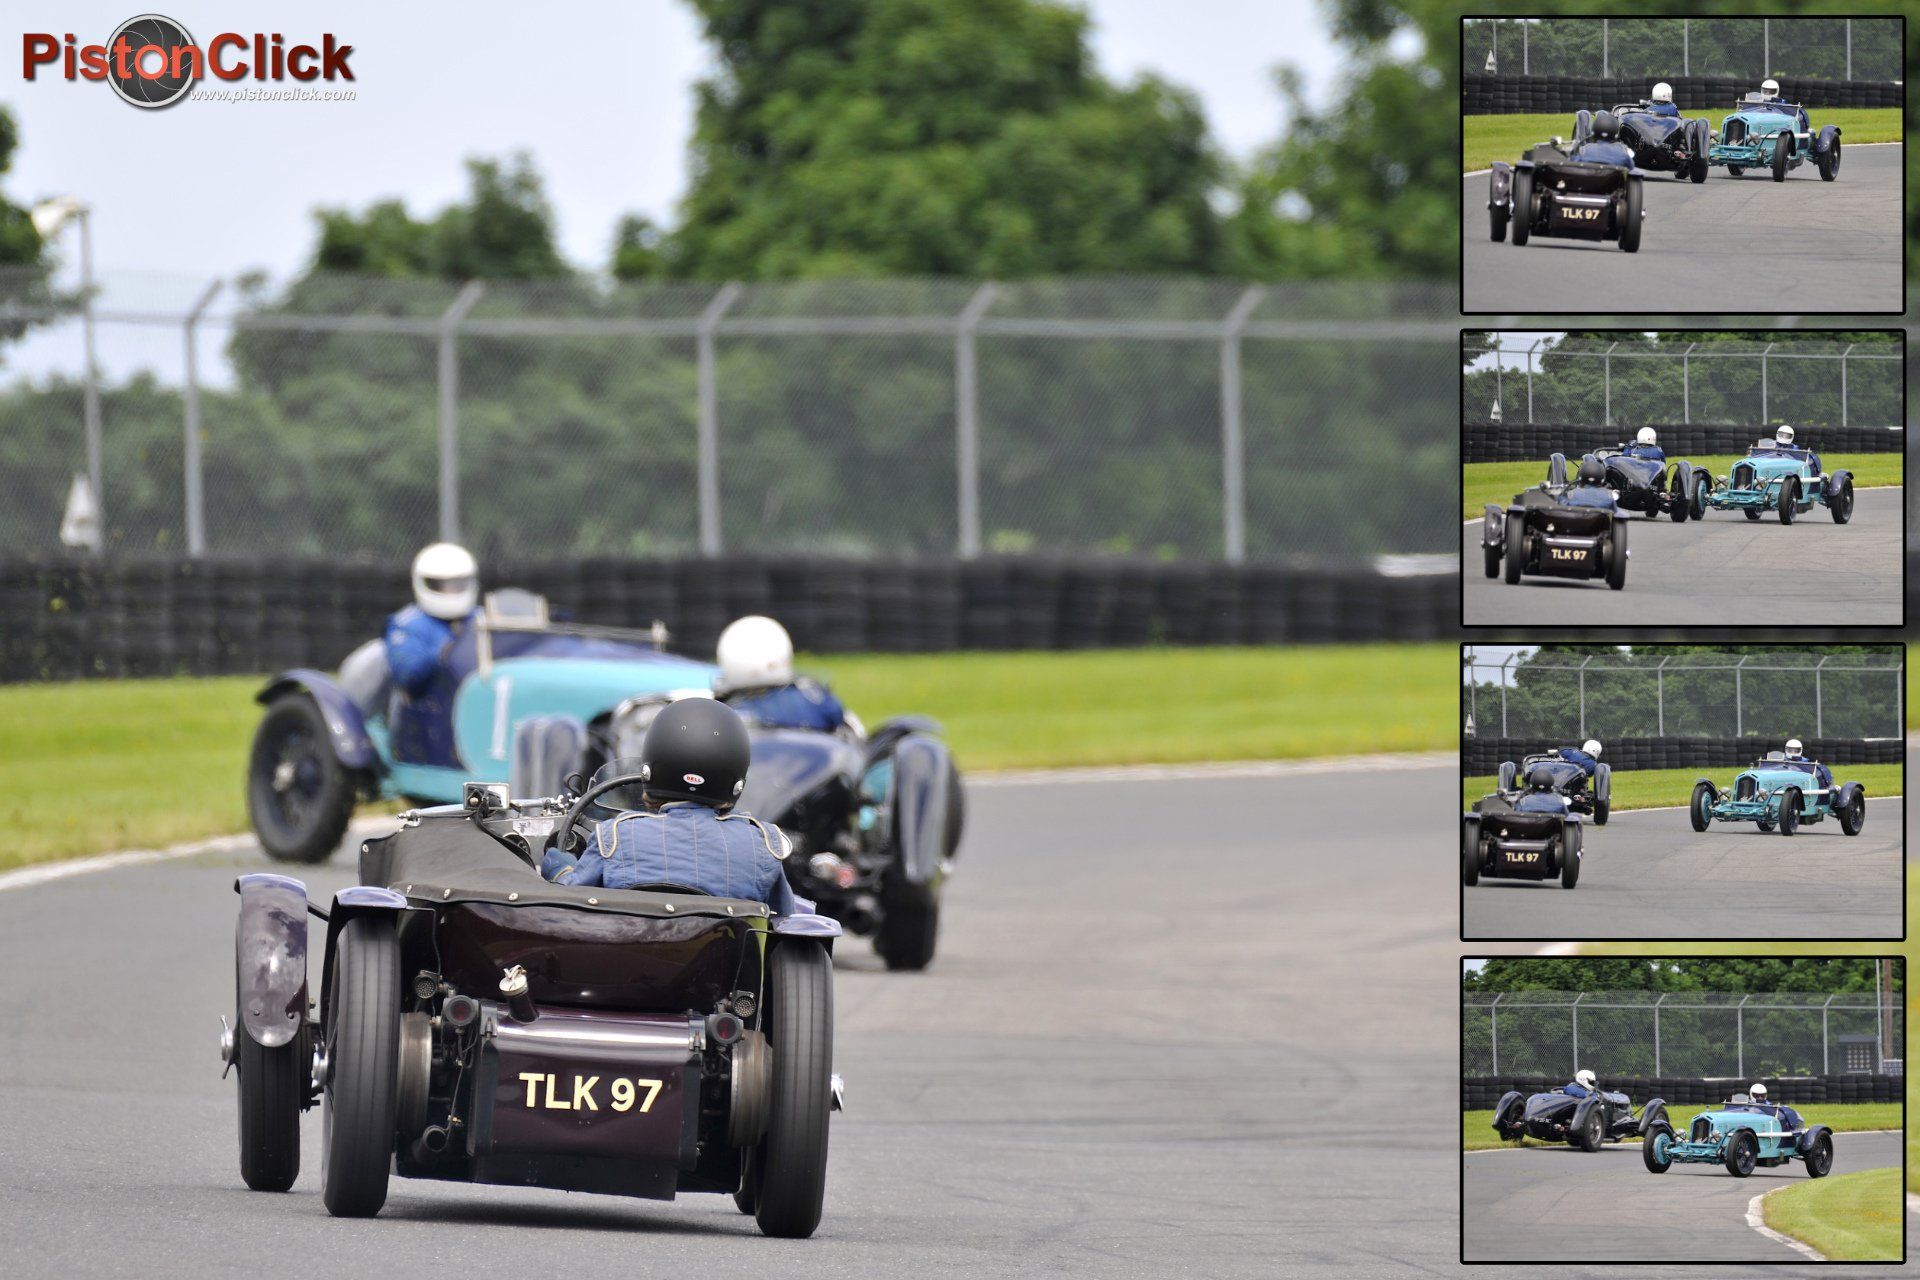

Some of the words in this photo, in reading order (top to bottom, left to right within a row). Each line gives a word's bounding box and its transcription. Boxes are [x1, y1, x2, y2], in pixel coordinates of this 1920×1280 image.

[1561, 207, 1583, 219] TLK
[1585, 209, 1600, 219] 97
[1551, 548, 1572, 559] TLK
[1573, 550, 1587, 560] 97
[1505, 852, 1525, 862] TLK
[1526, 853, 1539, 862] 97
[519, 1072, 600, 1111] TLK
[610, 1077, 663, 1113] 97
